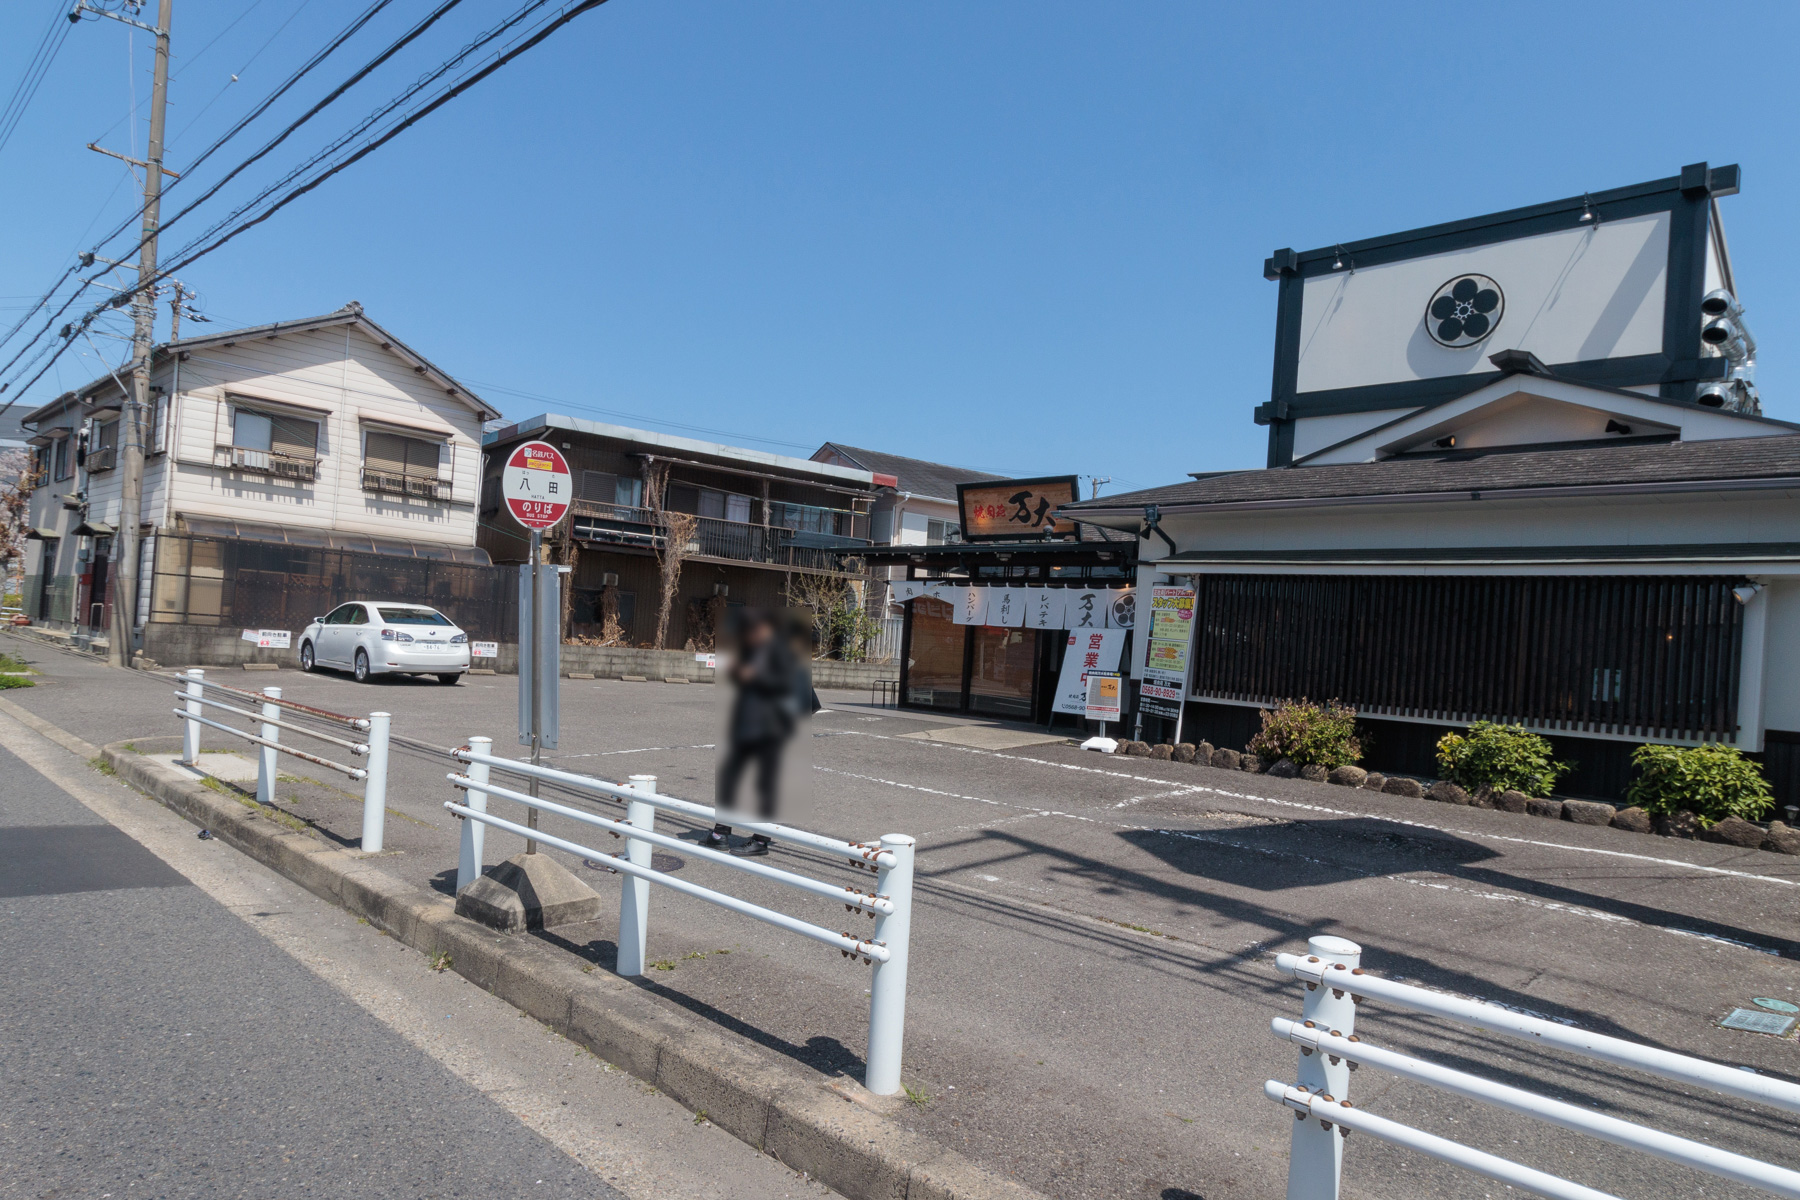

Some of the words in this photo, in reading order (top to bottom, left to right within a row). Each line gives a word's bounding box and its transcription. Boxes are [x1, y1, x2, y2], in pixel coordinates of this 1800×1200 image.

[532, 450, 554, 459] 名鉄バス
[522, 502, 553, 514] のりば
[1008, 490, 1057, 528] 万大
[966, 592, 976, 622] ハンバーグ
[1039, 594, 1049, 626] レバテキ
[1141, 685, 1176, 699] 0568-90-8929
